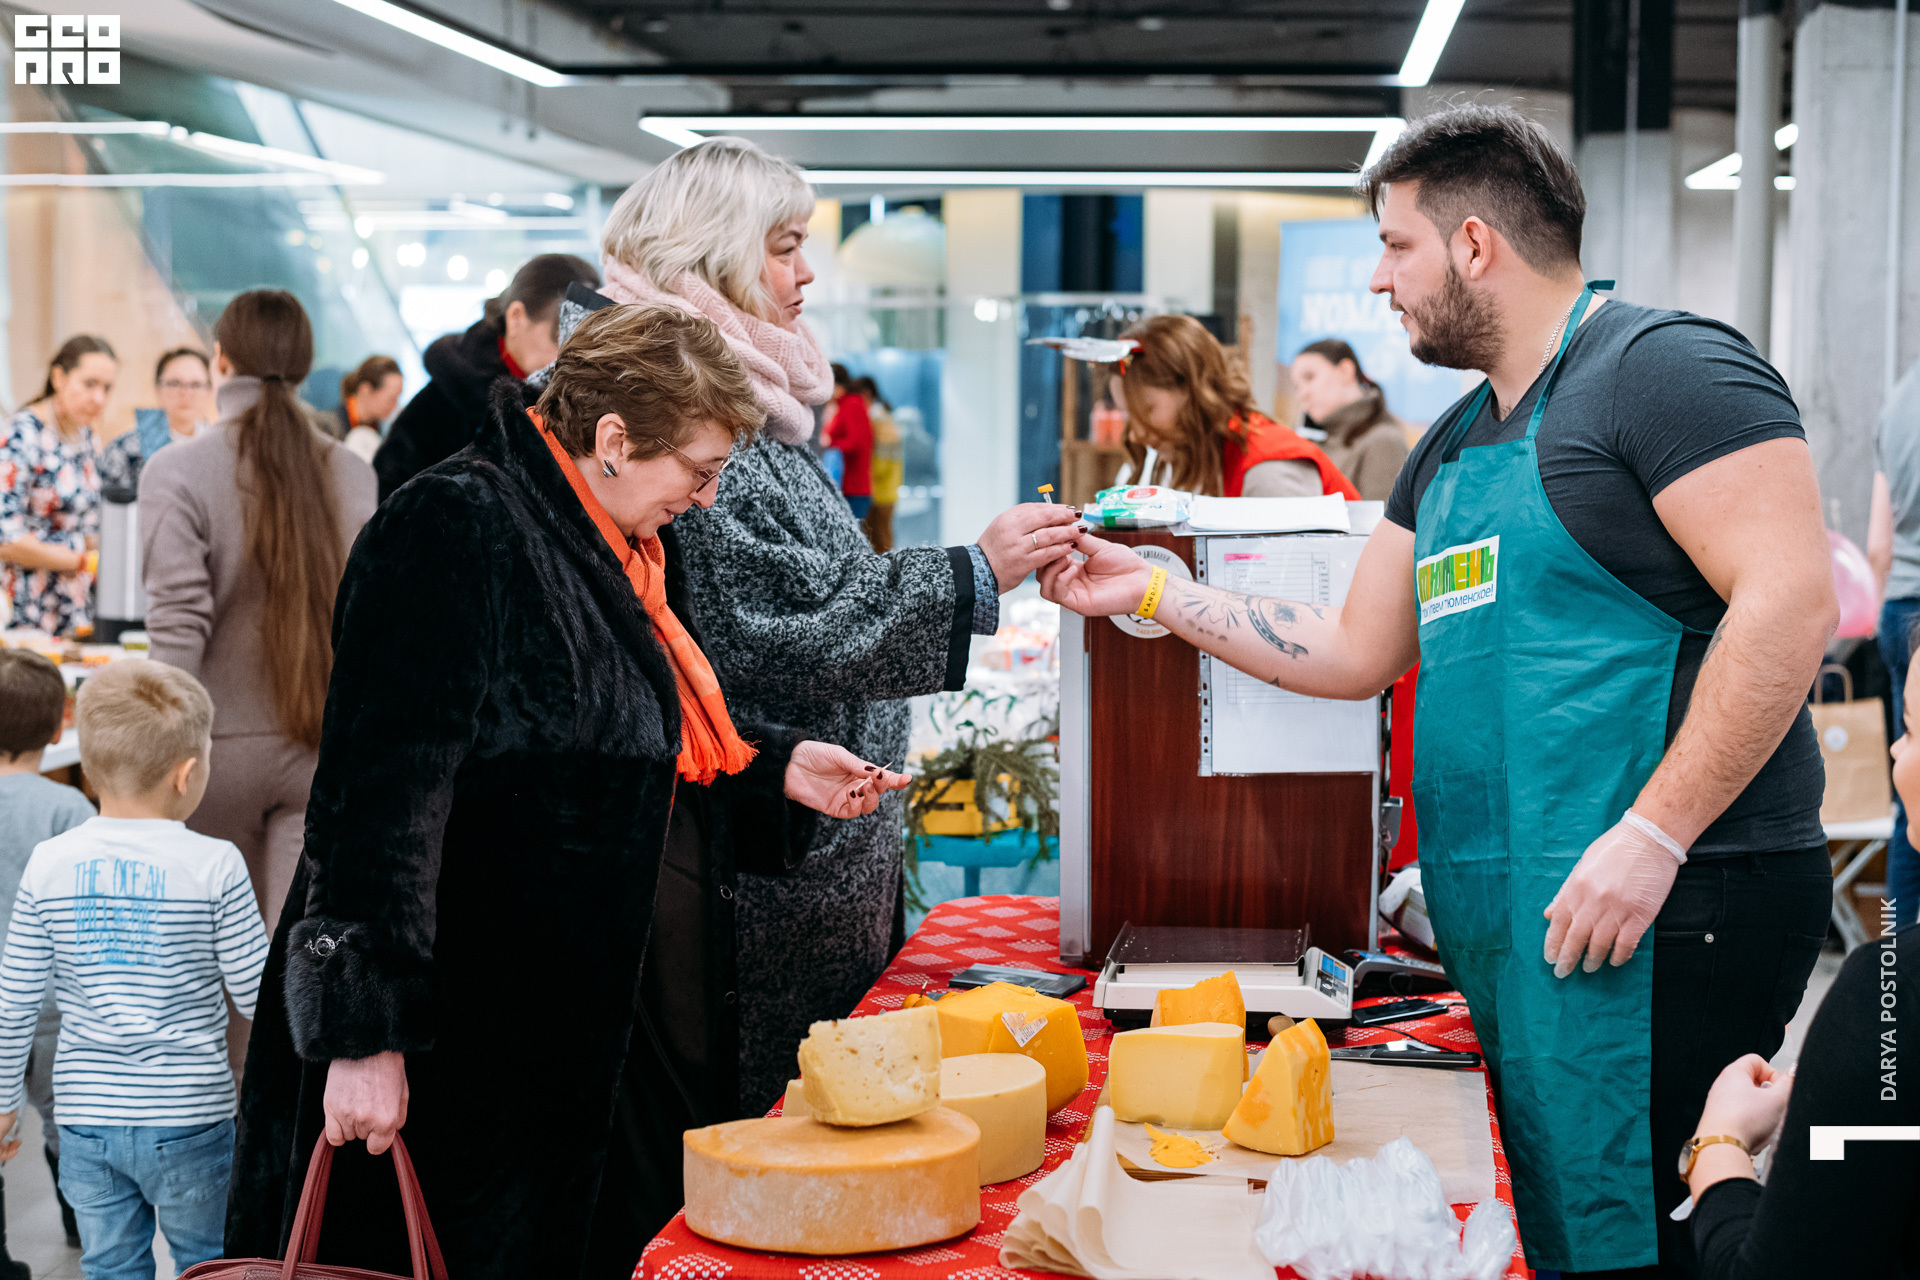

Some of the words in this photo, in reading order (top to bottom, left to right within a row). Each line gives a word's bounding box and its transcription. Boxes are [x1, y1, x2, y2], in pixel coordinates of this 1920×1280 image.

[1418, 545, 1495, 604] ТЮМЕНЬ
[74, 858, 106, 897] THE
[113, 858, 166, 900] OCEAN
